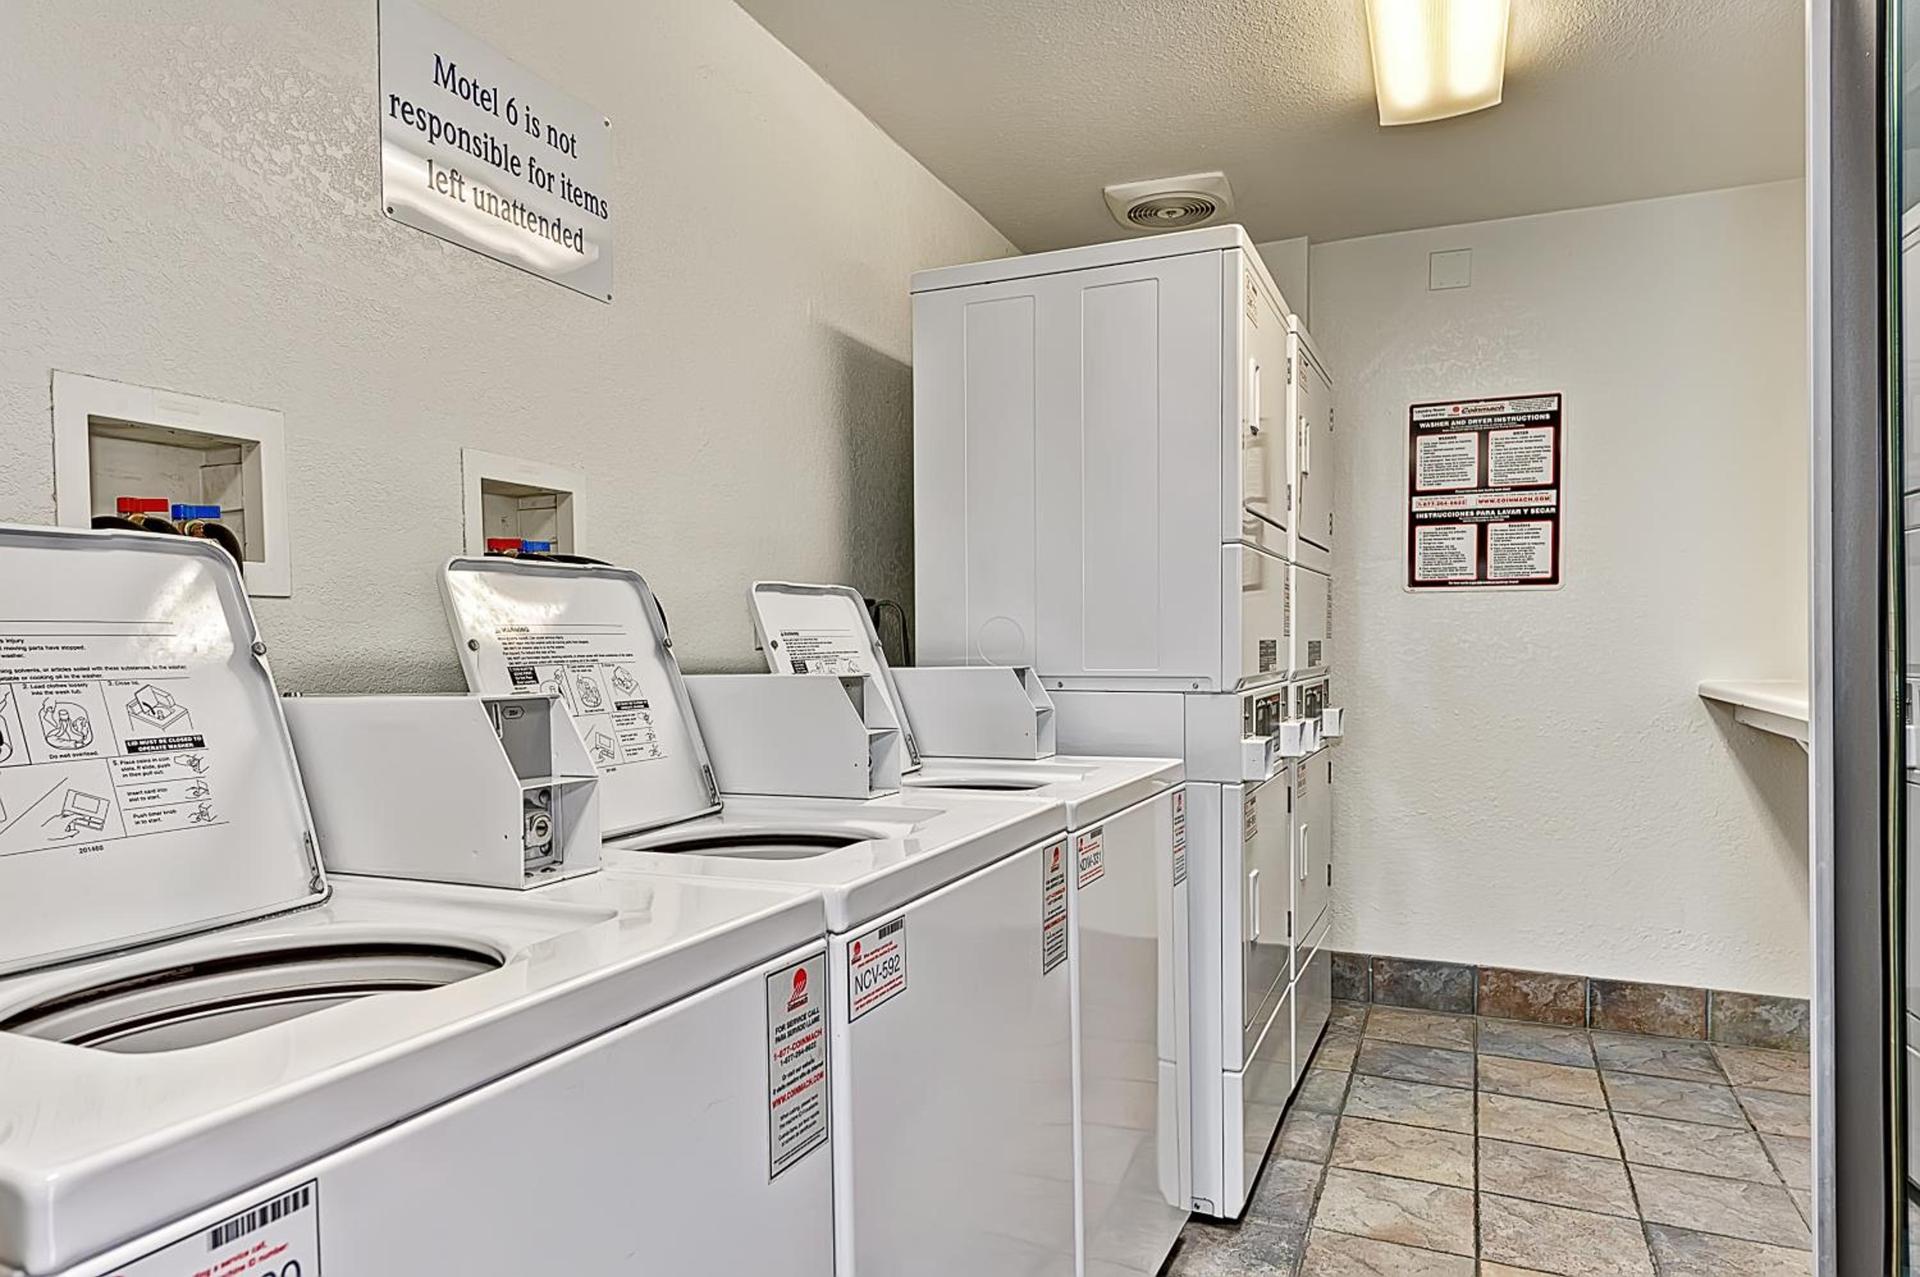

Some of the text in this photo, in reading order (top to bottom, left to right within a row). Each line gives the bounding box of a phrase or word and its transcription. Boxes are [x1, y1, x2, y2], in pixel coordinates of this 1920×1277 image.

[433, 53, 577, 159] Motel 6 is not
[389, 94, 609, 220] responsible for items
[427, 159, 585, 255] left unattended
[1461, 404, 1505, 414] Coinmach
[1419, 420, 1450, 429] WASHER
[1467, 416, 1492, 425] DRYER
[1493, 413, 1551, 423] INSTRUCTIONS
[1478, 496, 1550, 504] WWW.COINMACH.COM
[1416, 510, 1475, 519] INSTRUCCIONES
[854, 953, 901, 995] NCV-592
[775, 1006, 820, 1036] FOR SERVICE CALL
[773, 1027, 823, 1062] 1-877-COINMACH
[775, 1032, 787, 1045] PARA
[787, 1069, 795, 1078] visit
[772, 1070, 824, 1109] WWW.COINMACH.COM
[221, 1251, 249, 1268] service
[259, 1243, 289, 1261] number
